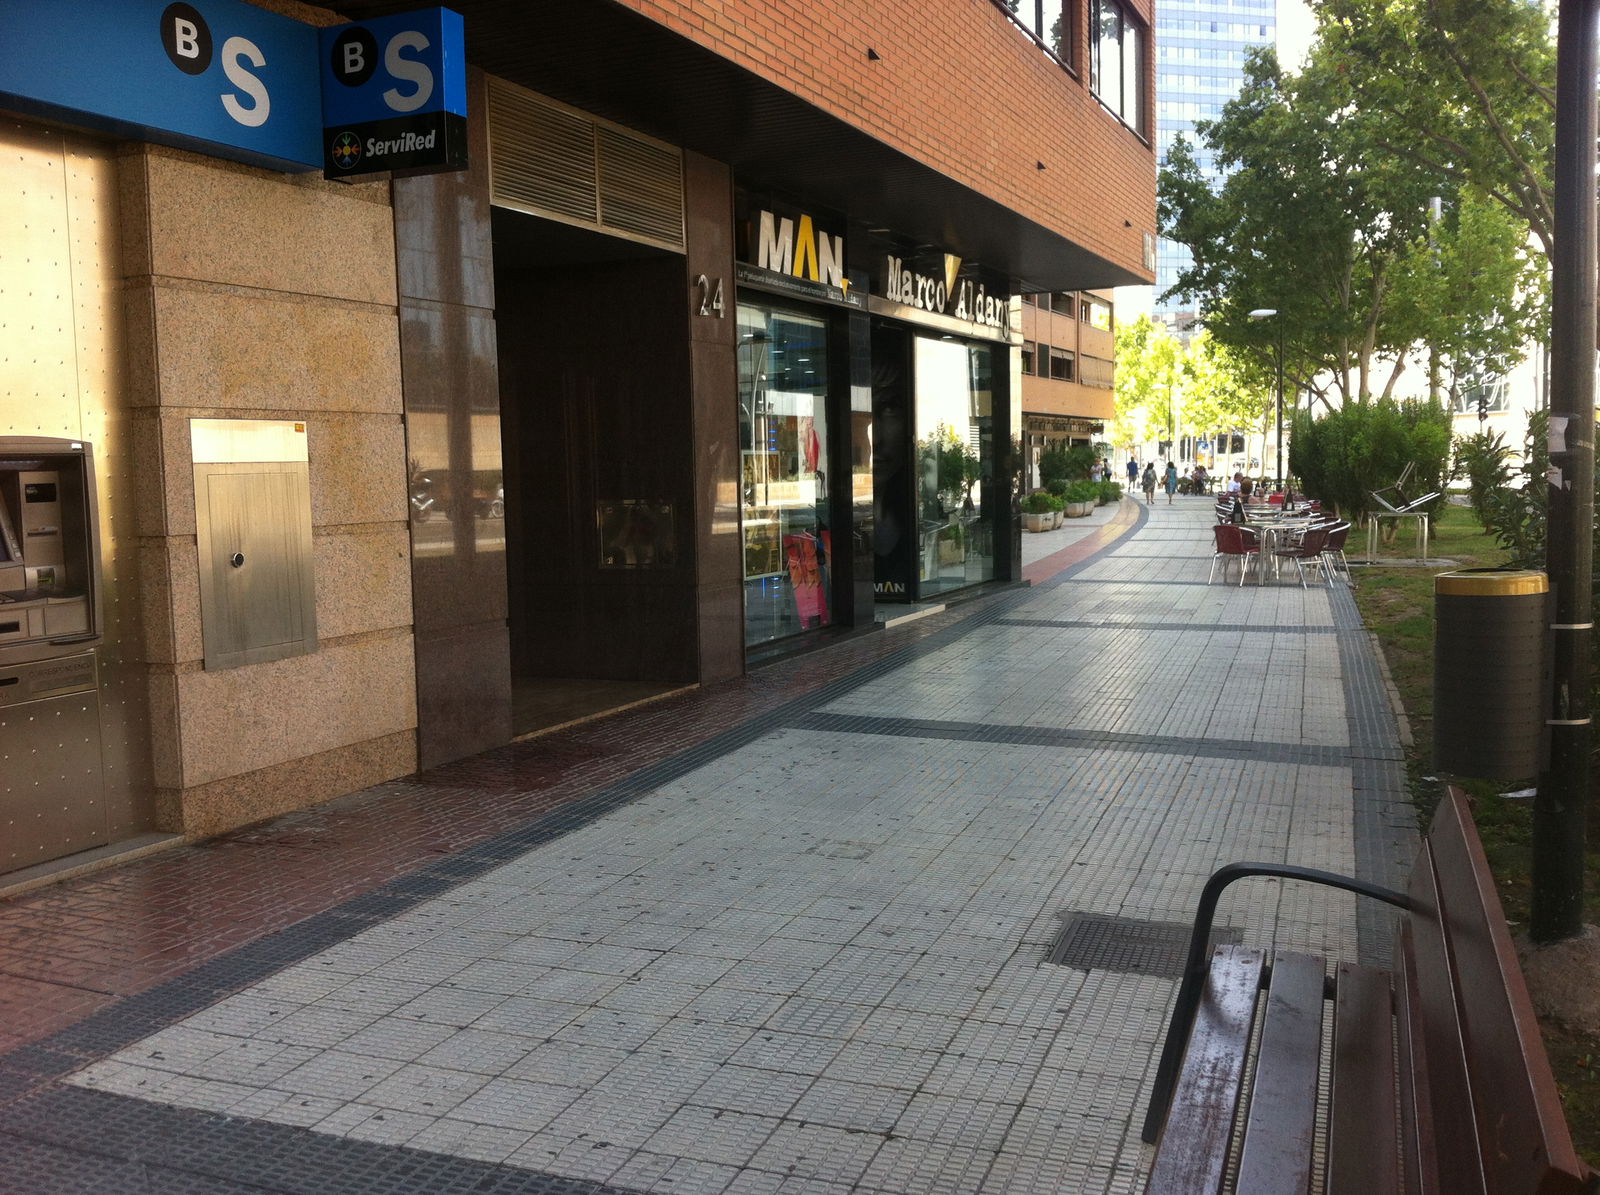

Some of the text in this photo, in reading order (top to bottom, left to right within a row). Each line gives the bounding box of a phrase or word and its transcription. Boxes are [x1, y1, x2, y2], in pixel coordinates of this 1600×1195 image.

[175, 17, 271, 128] B S
[343, 30, 434, 112] B S
[366, 129, 436, 158] ServiRed
[758, 209, 844, 288] MAN
[697, 274, 725, 318] 24
[887, 254, 945, 314] Marco
[955, 278, 1011, 339] Aldany
